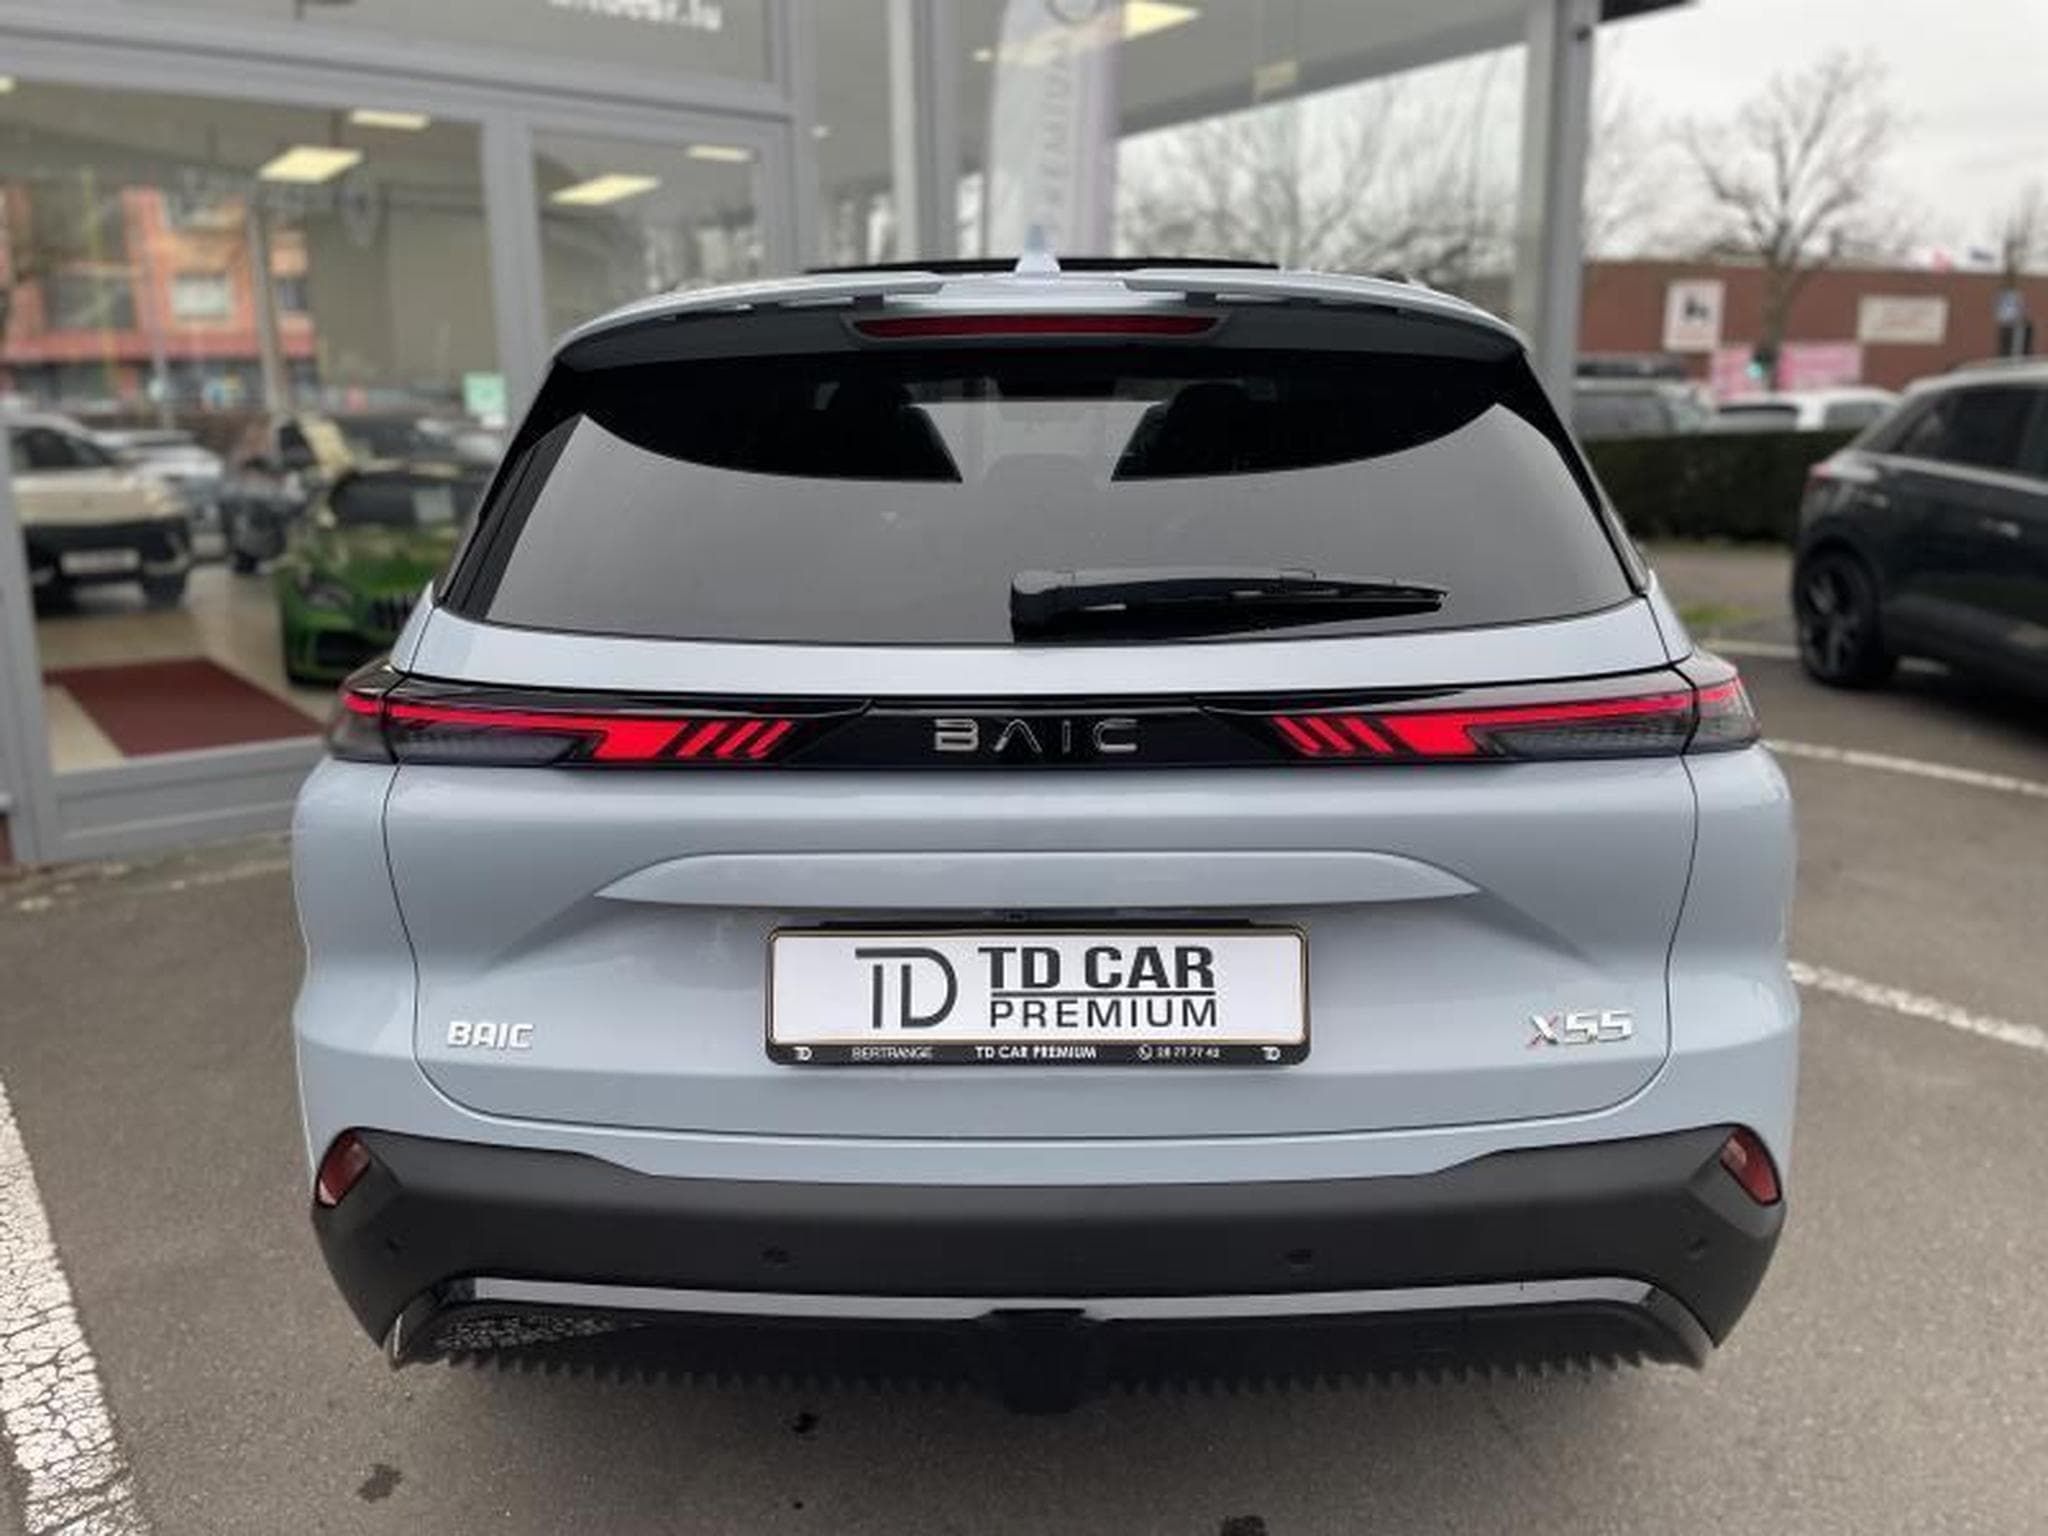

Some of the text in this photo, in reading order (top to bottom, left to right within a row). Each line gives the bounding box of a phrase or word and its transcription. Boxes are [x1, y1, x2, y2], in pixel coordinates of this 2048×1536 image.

[934, 717, 1138, 752] BAIC
[978, 945, 1214, 989] TD CAR
[990, 999, 1217, 1028] PREMIUM
[1528, 1009, 1635, 1047] X55
[447, 1020, 535, 1049] BAIC
[851, 1046, 933, 1060] BERTRANGE
[974, 1046, 1097, 1059] TD CAR PREMIUM
